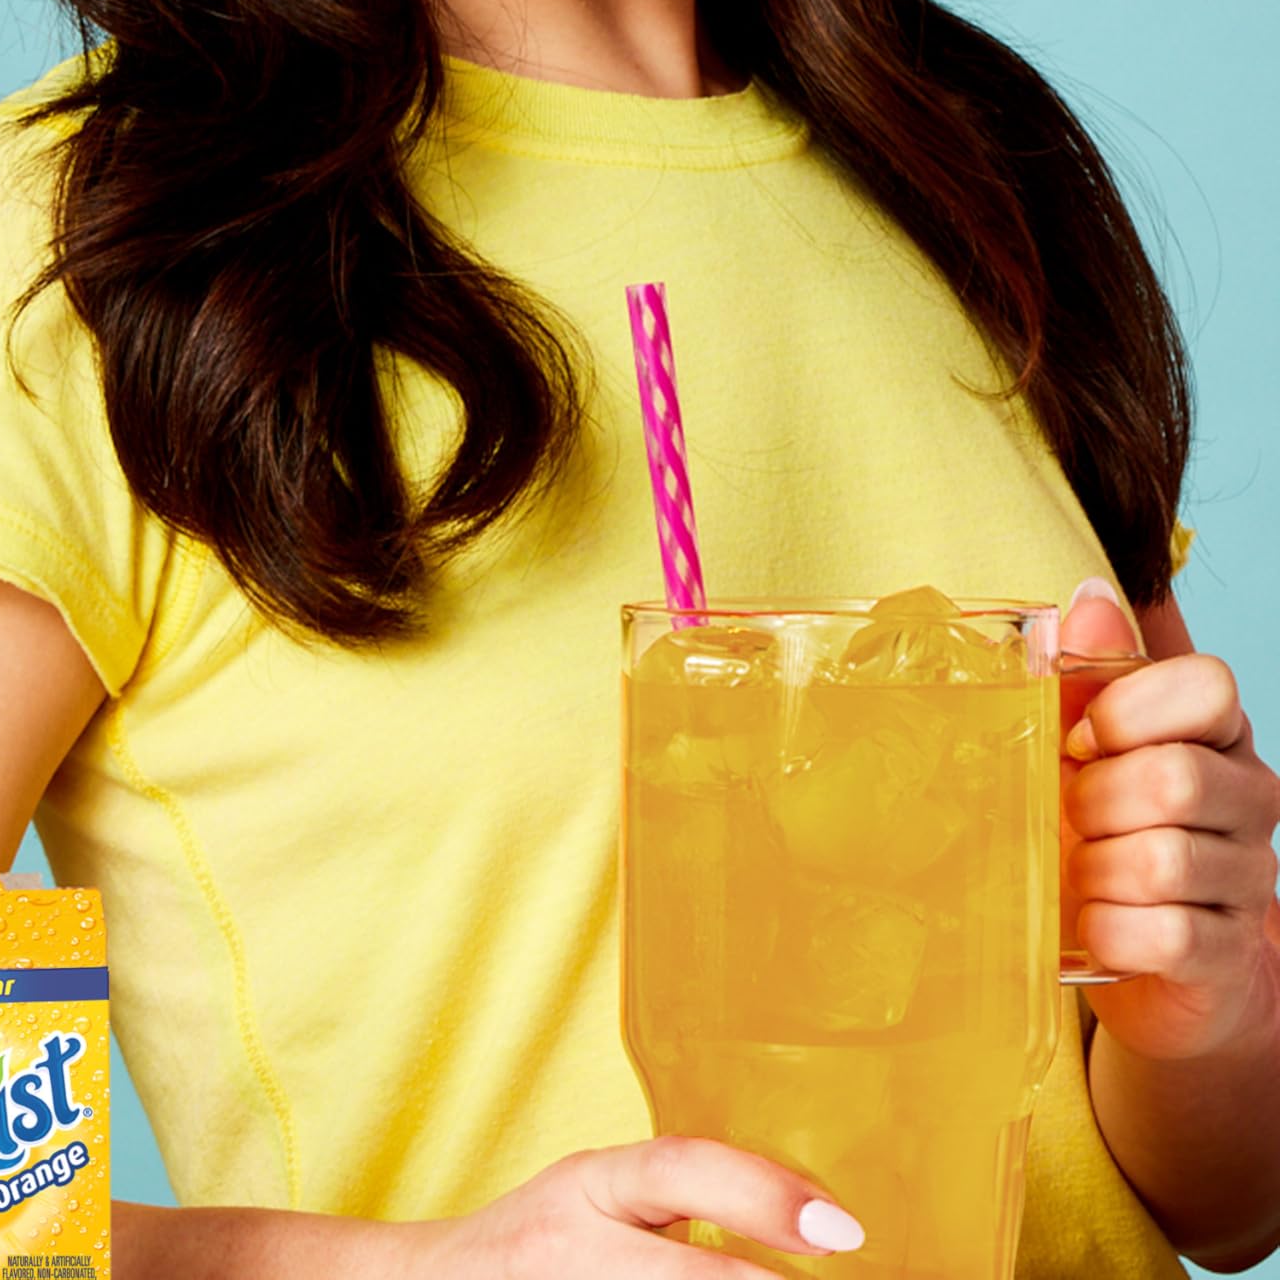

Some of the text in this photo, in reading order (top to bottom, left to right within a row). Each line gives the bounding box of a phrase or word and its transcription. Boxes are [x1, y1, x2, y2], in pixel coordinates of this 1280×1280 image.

[7, 1255, 92, 1266] NATURALLY & ARTIFICIALLY
